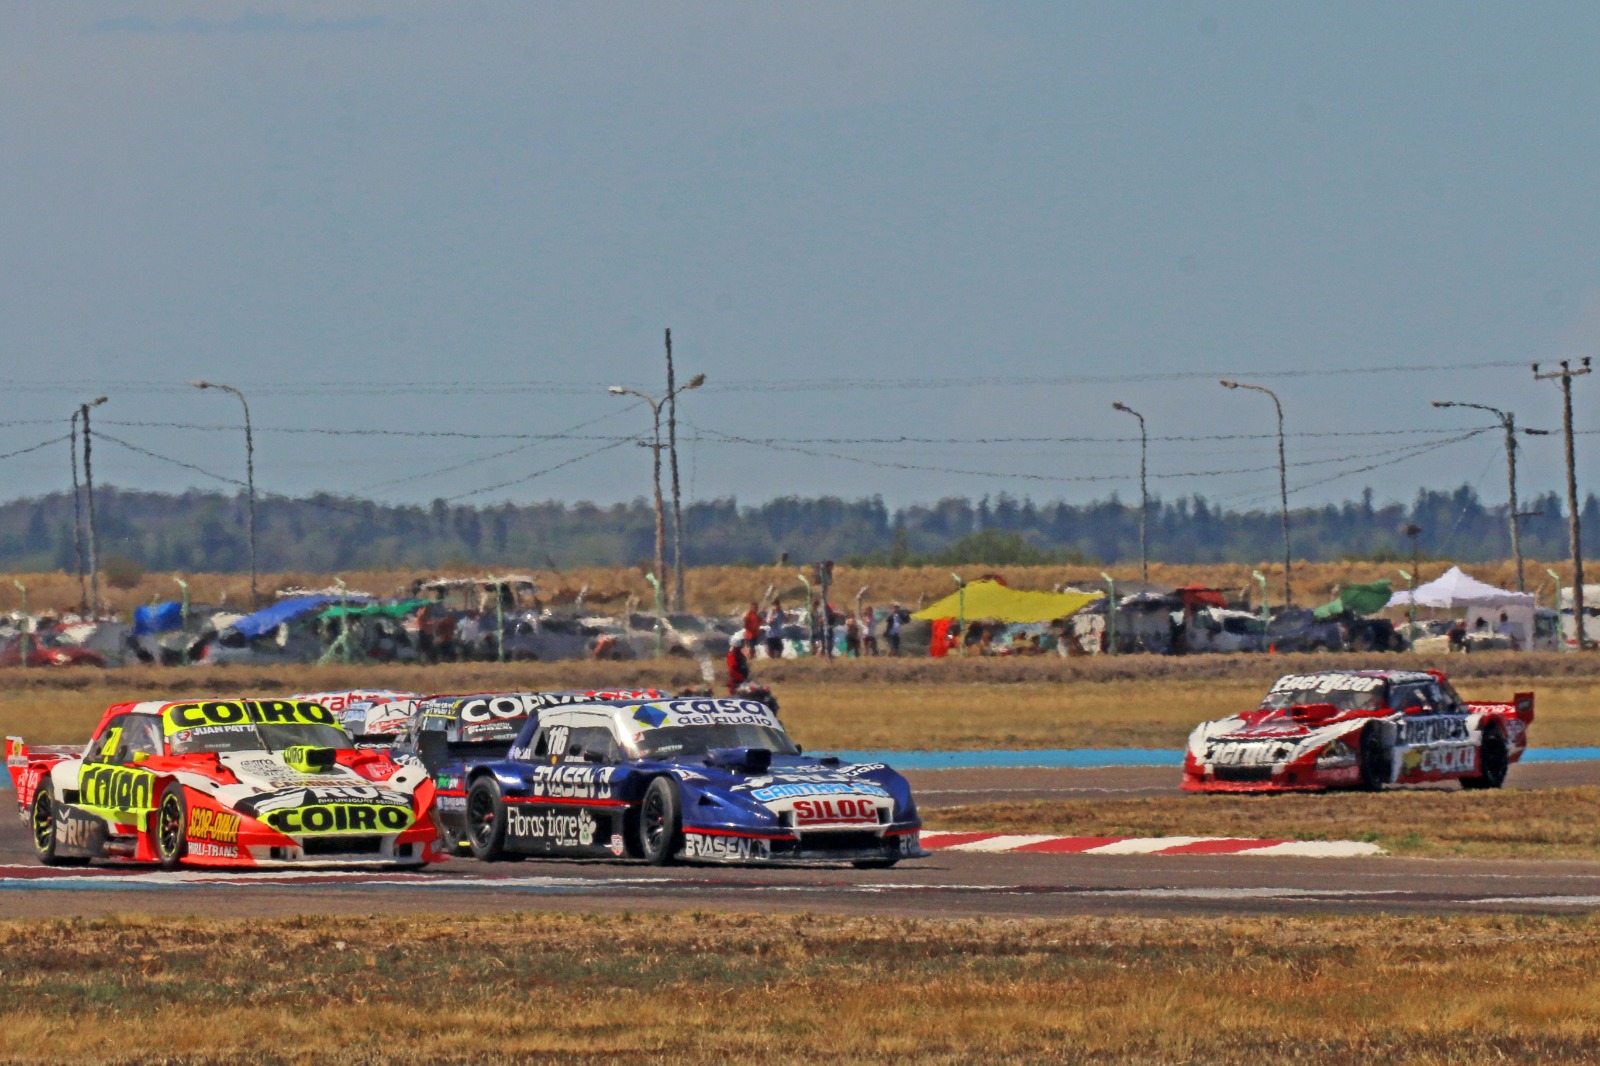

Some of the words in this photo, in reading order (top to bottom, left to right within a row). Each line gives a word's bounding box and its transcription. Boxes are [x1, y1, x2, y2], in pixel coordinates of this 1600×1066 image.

[170, 700, 336, 727] COIRO
[669, 699, 767, 717] casa
[193, 726, 223, 736] JUAN
[678, 715, 710, 725] del
[714, 715, 772, 727] audio
[548, 727, 569, 755] 116
[274, 806, 409, 831] COIRO
[793, 799, 876, 818] SILOC
[507, 806, 546, 838] Fibras
[547, 808, 578, 845] tigre
[685, 833, 751, 858] BRASEN
